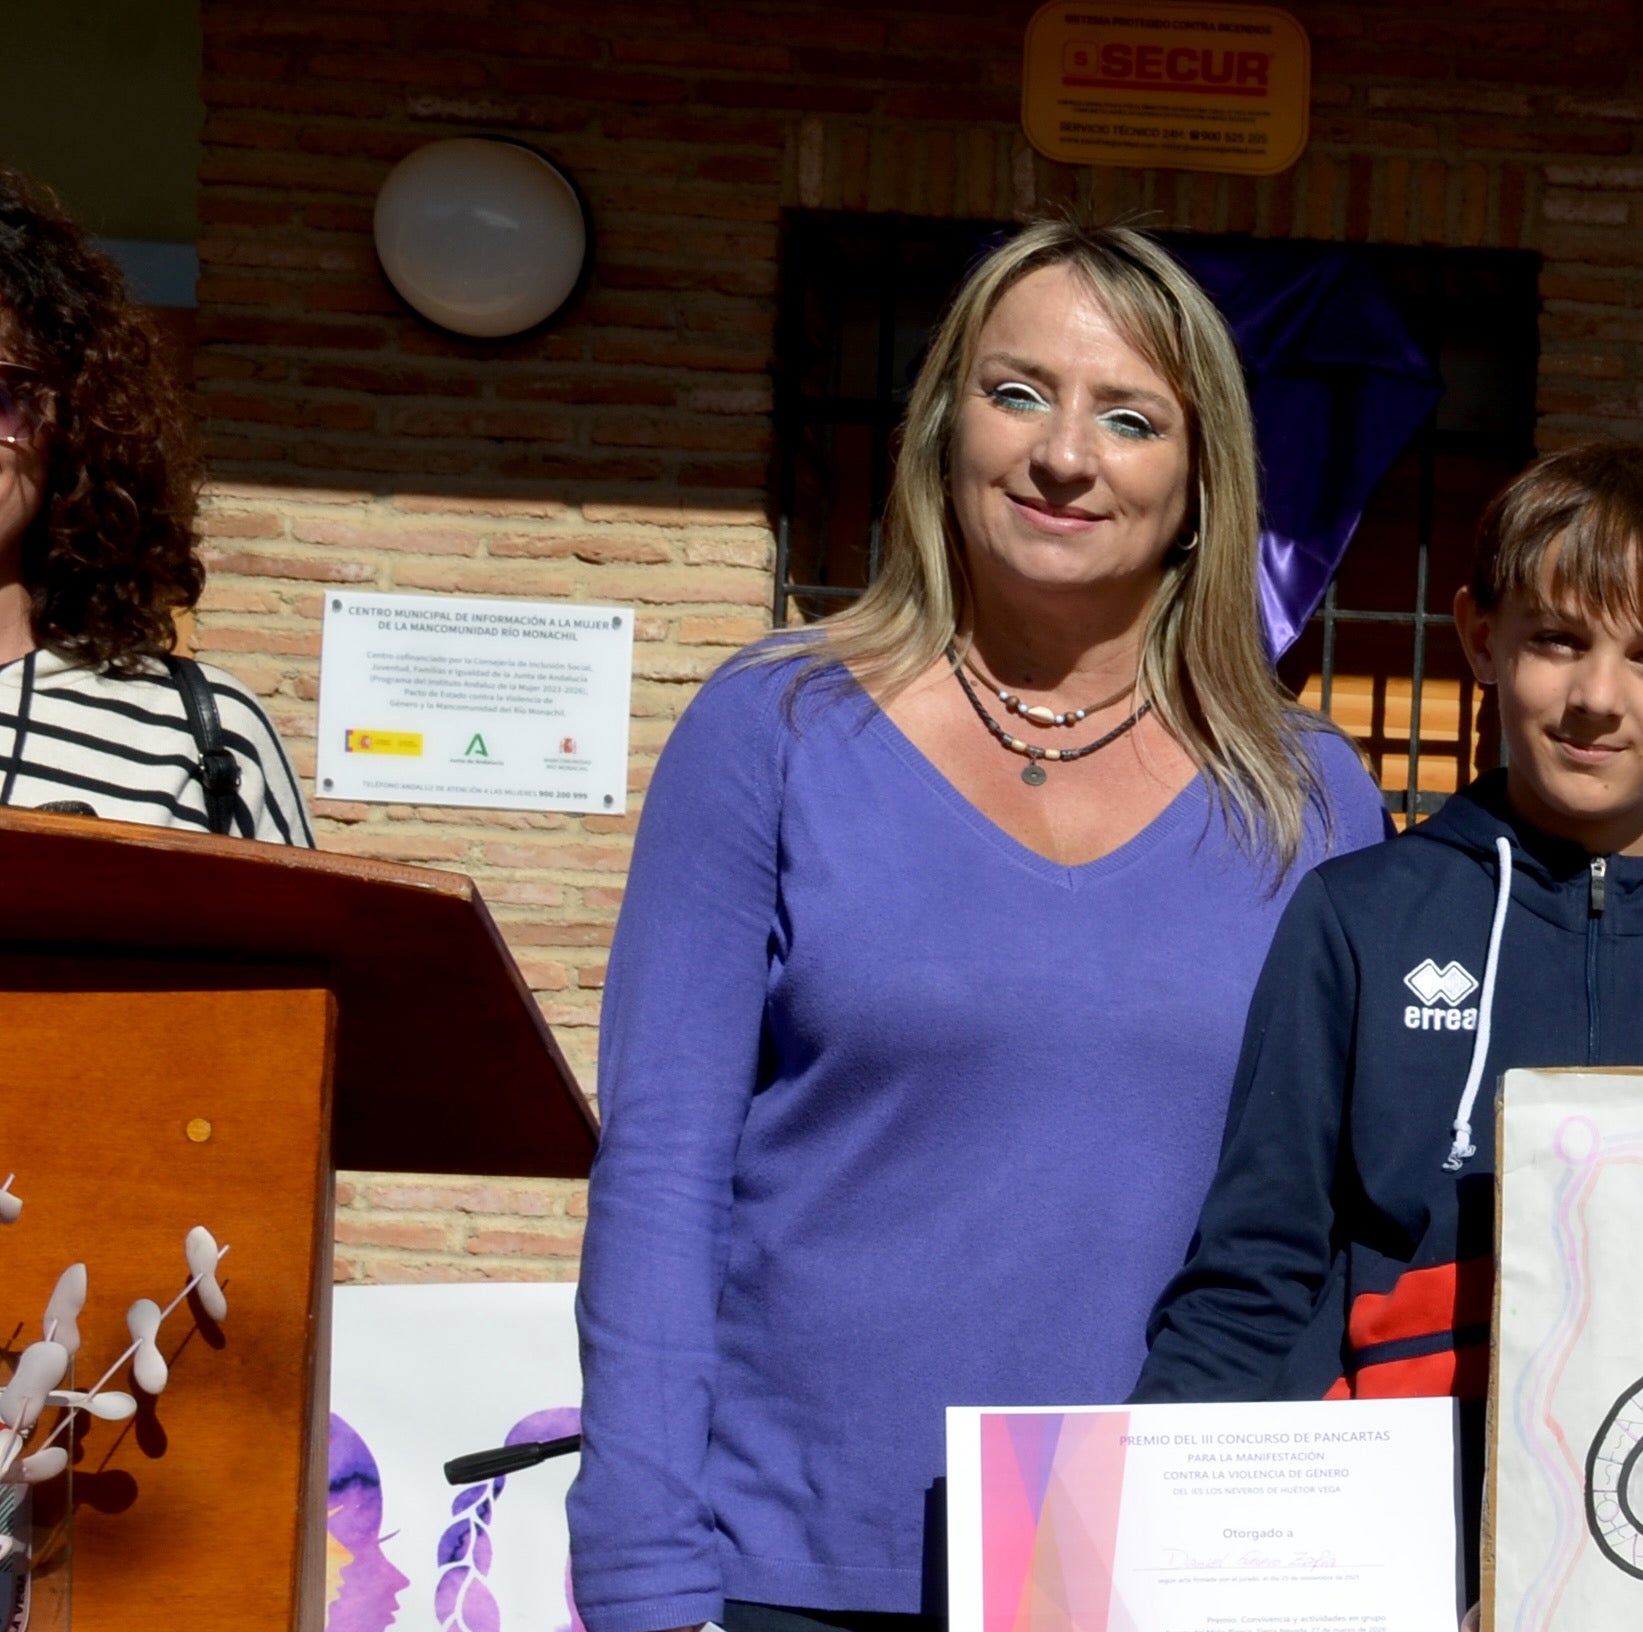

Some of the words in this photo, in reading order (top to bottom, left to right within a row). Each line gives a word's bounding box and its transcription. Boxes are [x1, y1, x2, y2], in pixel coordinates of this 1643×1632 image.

[1101, 43, 1269, 85] SECUR
[348, 606, 392, 618] CENTRO
[393, 609, 452, 621] MUNICIPAL
[453, 612, 469, 622] DE
[470, 611, 546, 626] INFORMACIÓN
[547, 618, 556, 627] A
[557, 618, 572, 628] LA
[573, 619, 610, 630] MUJER
[378, 621, 393, 631] DE
[395, 622, 409, 632] LA
[410, 623, 500, 637] MANCOMUNIDAD
[501, 626, 521, 638] RÍO
[522, 629, 578, 641] MONACHIL
[1404, 1006, 1478, 1030] errea
[1119, 1434, 1171, 1446] PREMIO
[1173, 1434, 1199, 1445] DEL
[1201, 1434, 1213, 1445] III
[1216, 1432, 1291, 1444] CONCURSO
[1293, 1432, 1312, 1443] DE
[1314, 1431, 1391, 1443] PANCARTAS
[1187, 1453, 1217, 1463] PARA
[1218, 1453, 1233, 1462] LA
[1235, 1449, 1325, 1462] MANIFESTACIÓN
[1163, 1470, 1209, 1480] CONTRA
[1210, 1470, 1225, 1479] LA
[1226, 1469, 1284, 1479] VIOLENCIA
[1286, 1469, 1302, 1478] DE
[1303, 1466, 1350, 1478] GÉNERO
[1222, 1527, 1283, 1542] Otorgado
[1285, 1530, 1294, 1538] a
